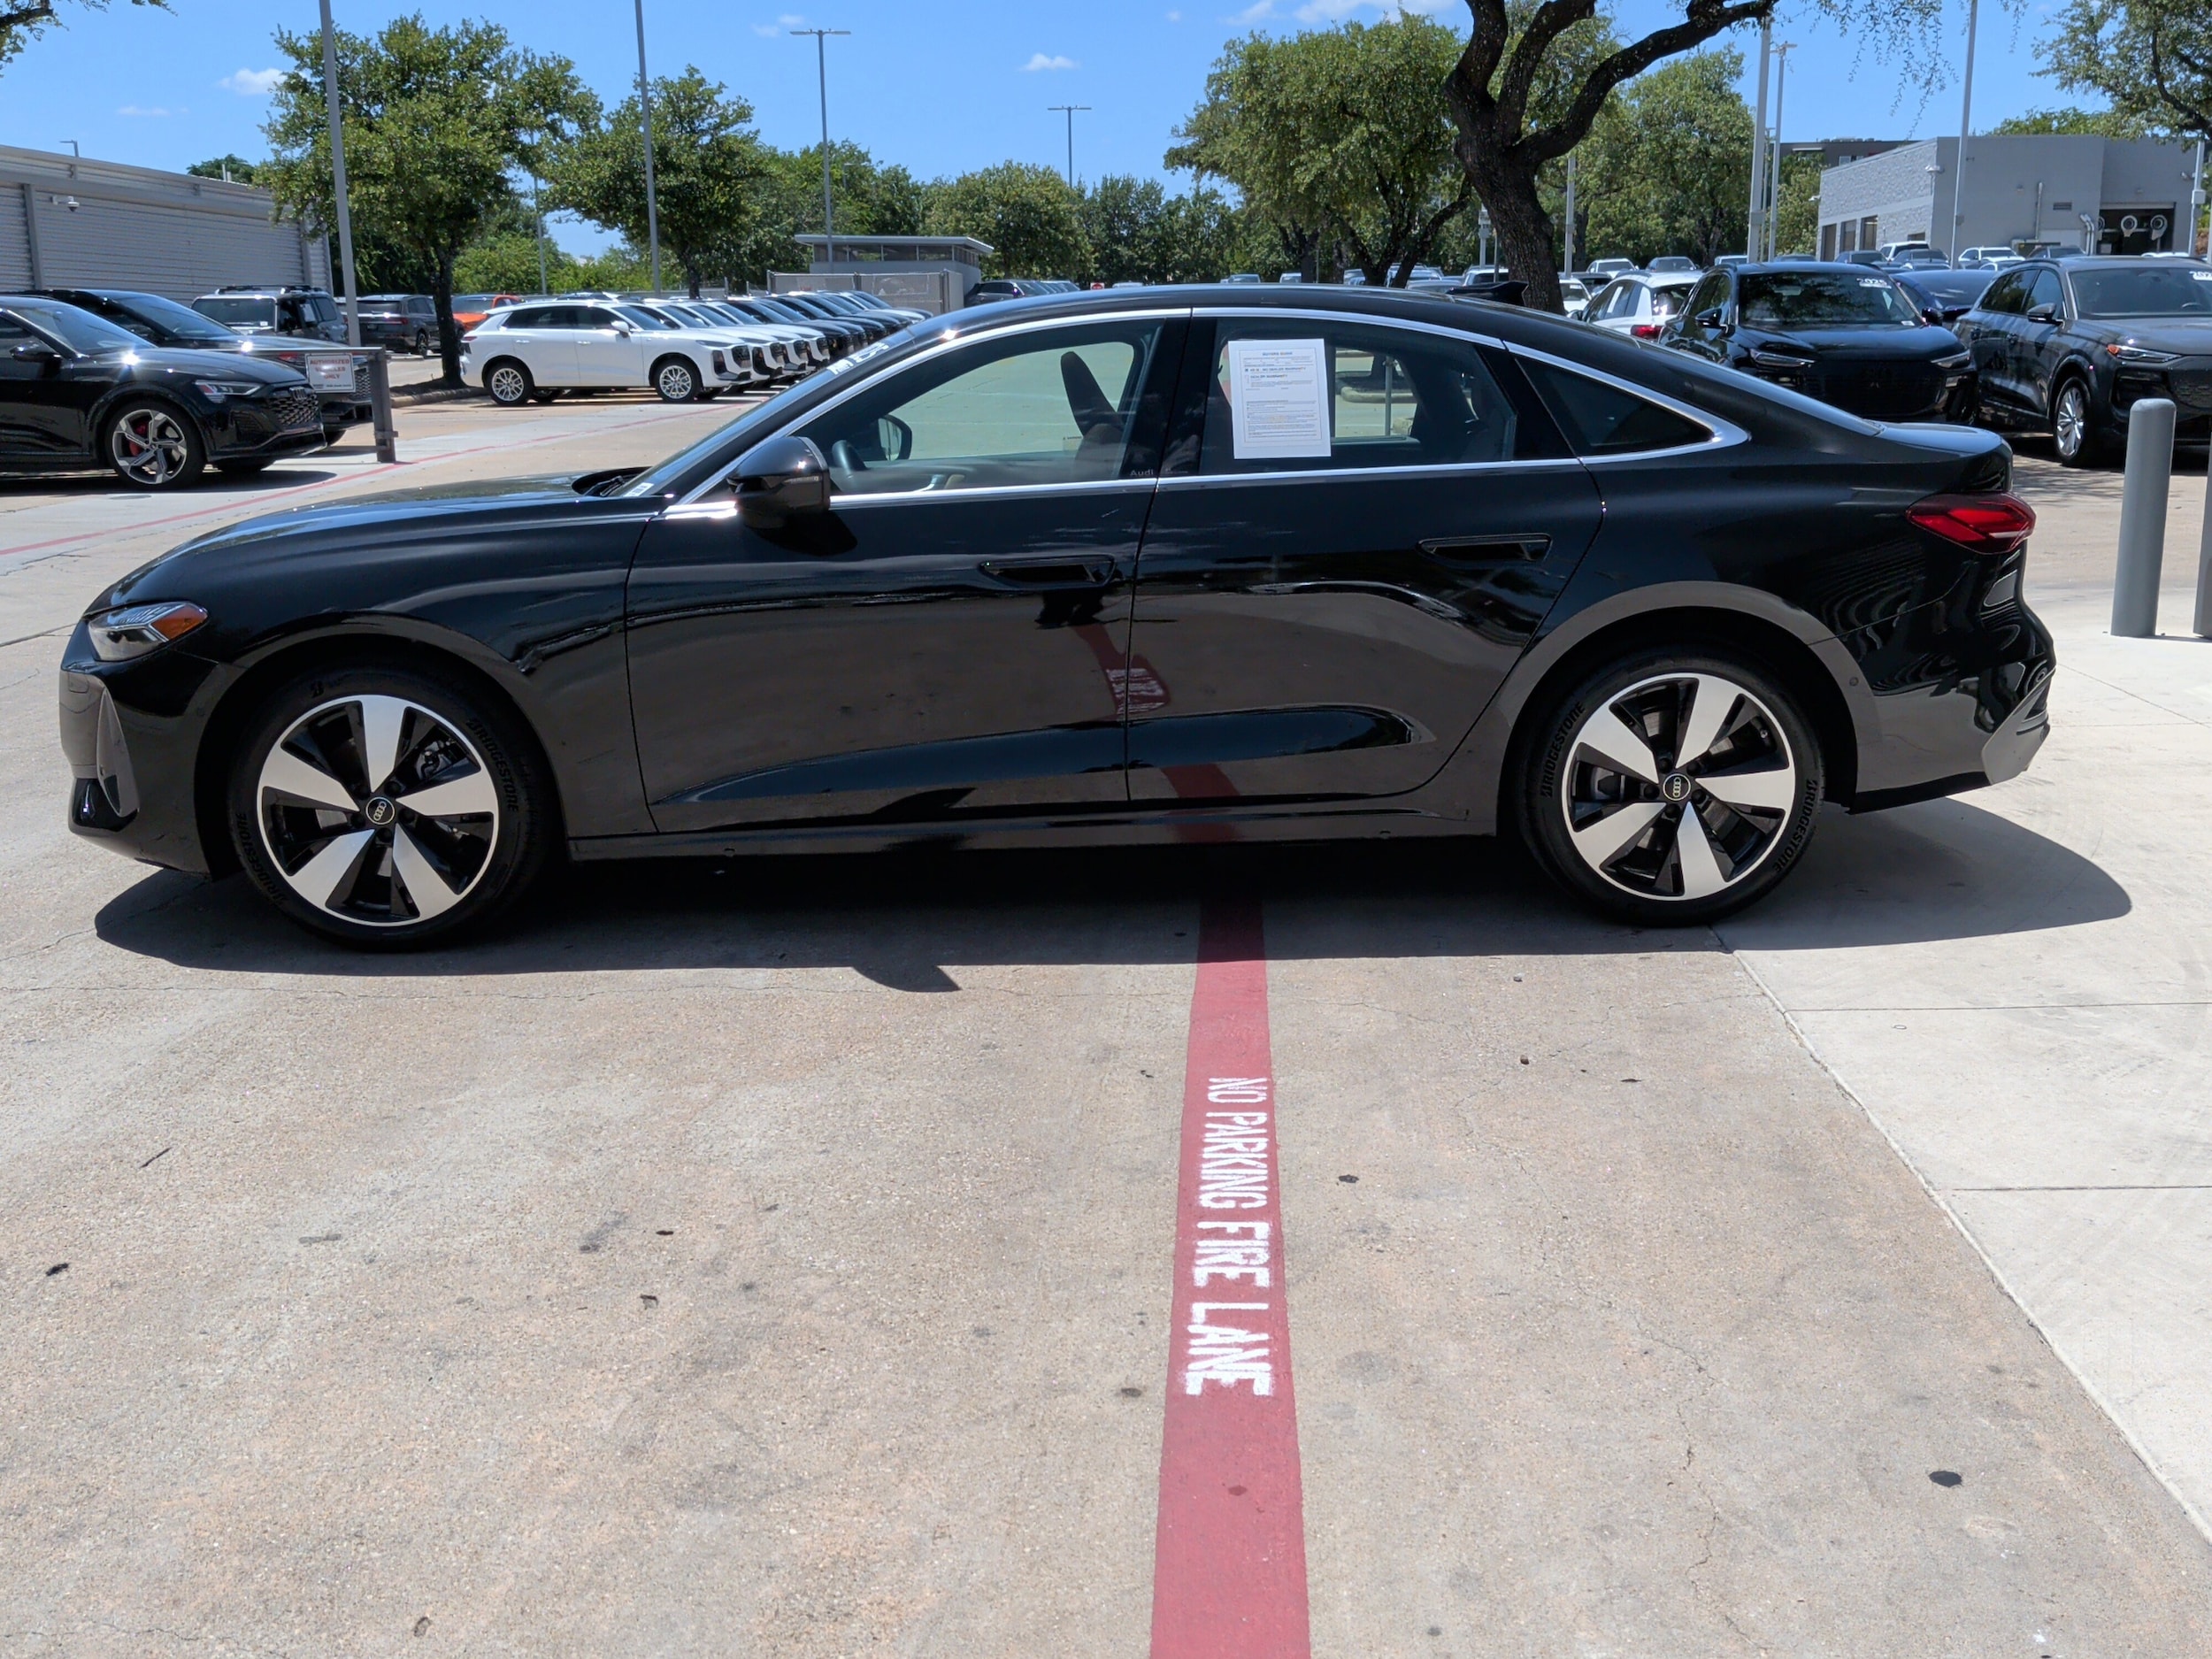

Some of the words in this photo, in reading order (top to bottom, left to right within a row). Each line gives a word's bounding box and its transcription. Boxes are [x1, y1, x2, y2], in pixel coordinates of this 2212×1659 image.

[465, 718, 519, 812] BRIDGESTONE
[1540, 701, 1586, 797] BRIDGESTONE
[1774, 779, 1817, 874] BRIDGESTONE
[1207, 1077, 1268, 1103] NO
[1198, 1111, 1269, 1210] PARKING
[1193, 1220, 1272, 1287] FIRE
[1183, 1302, 1274, 1397] LANE
